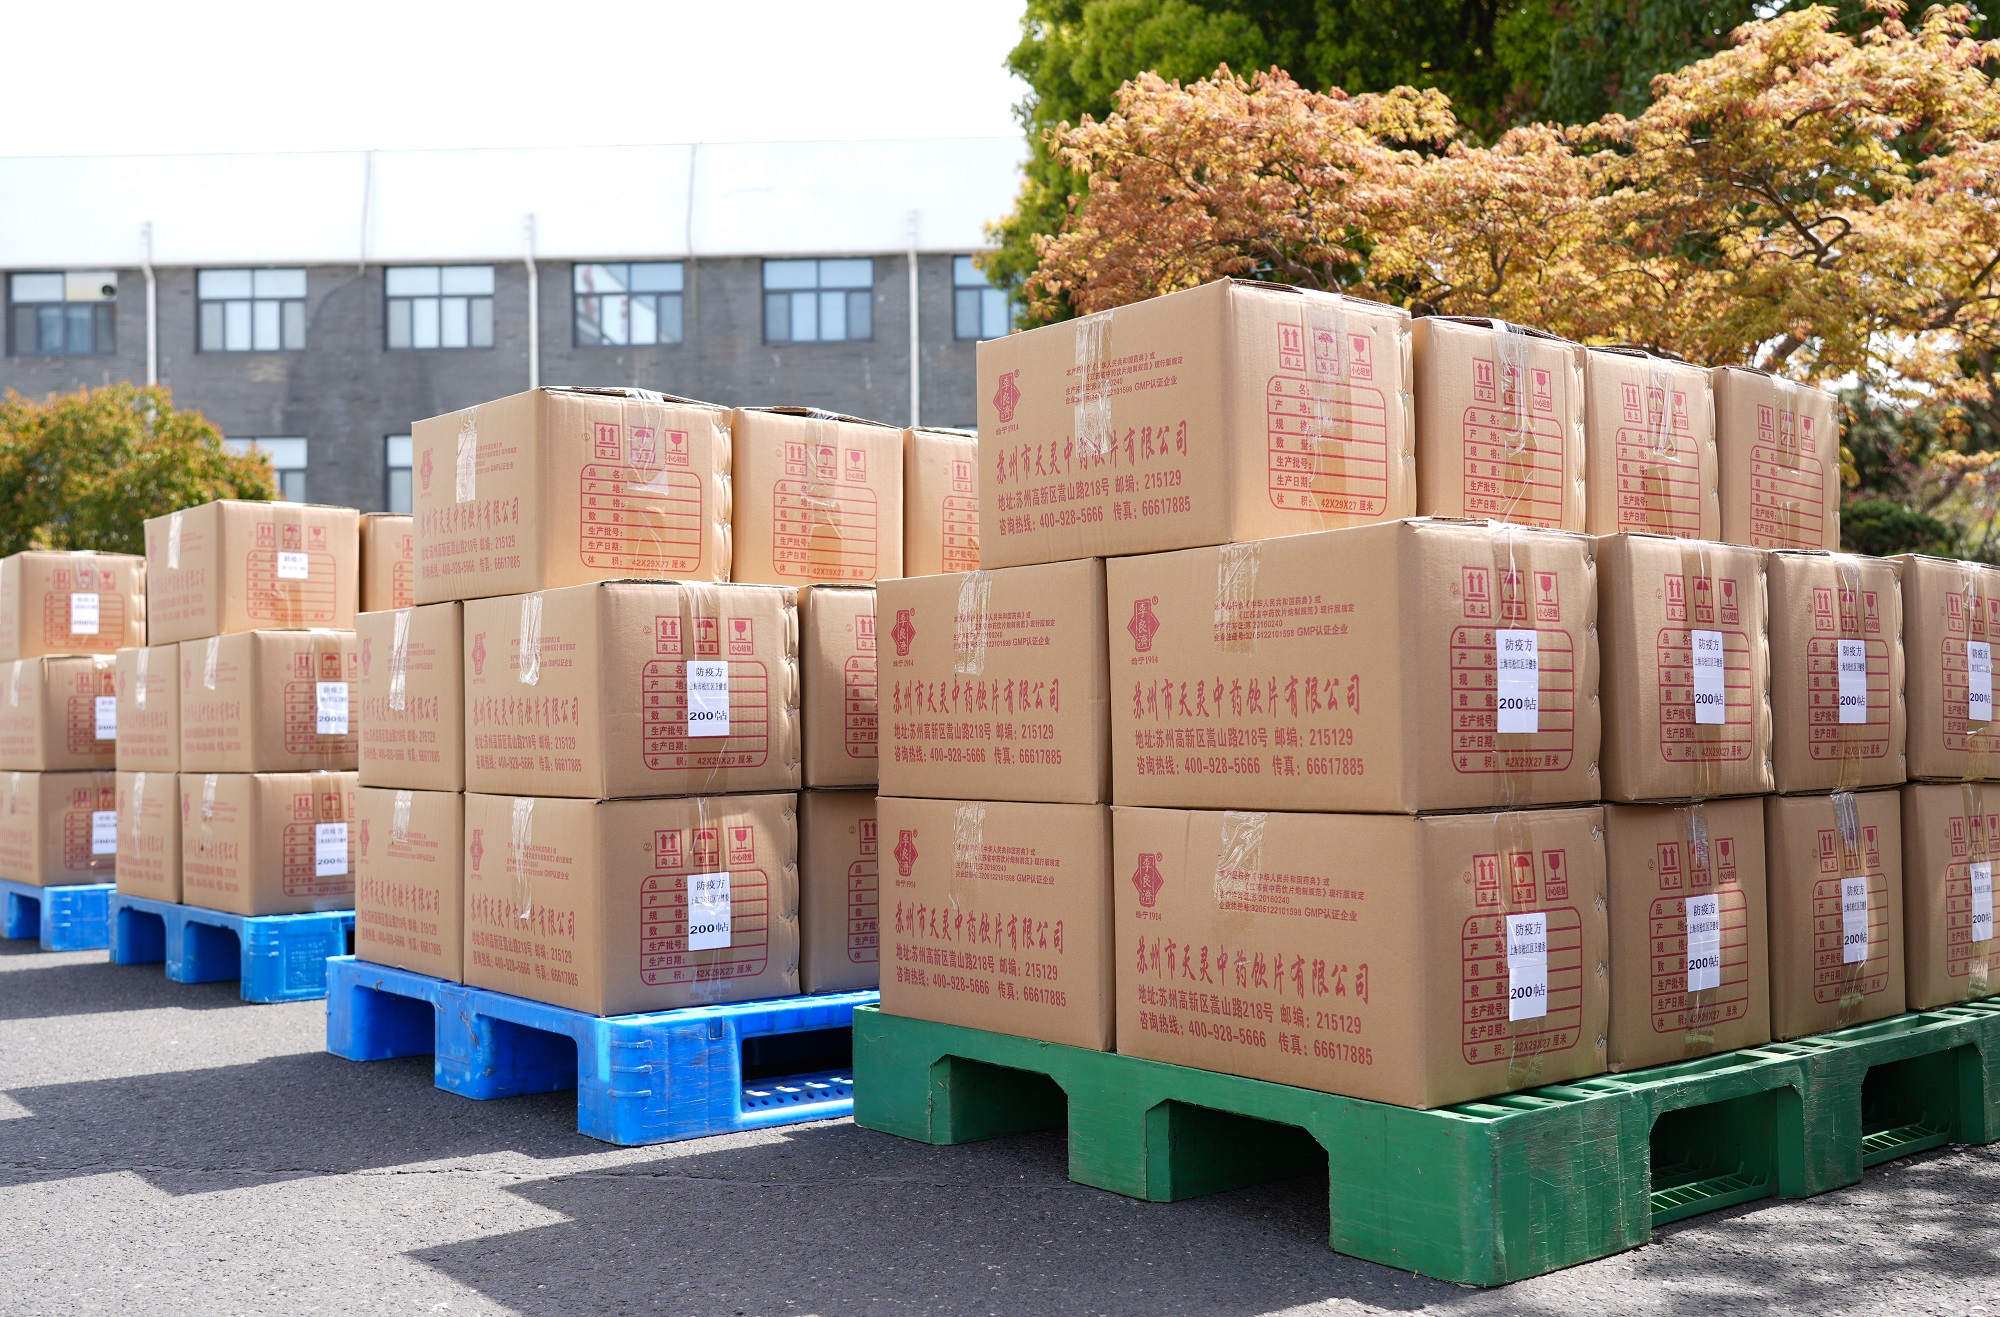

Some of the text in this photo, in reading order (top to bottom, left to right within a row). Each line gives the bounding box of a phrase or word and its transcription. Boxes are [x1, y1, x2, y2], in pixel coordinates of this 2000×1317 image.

[1505, 638, 1532, 651] 防疫方
[696, 667, 723, 676] 防疫方
[1132, 672, 1361, 720] 苏州市天灵中药饮片有限公司
[1498, 697, 1536, 710] 200帖
[696, 878, 724, 890] 防疫方
[1847, 884, 1864, 896] 防疫方
[1515, 921, 1542, 936] 防疫方
[1135, 933, 1370, 1007] 苏州市天灵中药饮片有限公司
[1510, 982, 1545, 1000] 200帖
